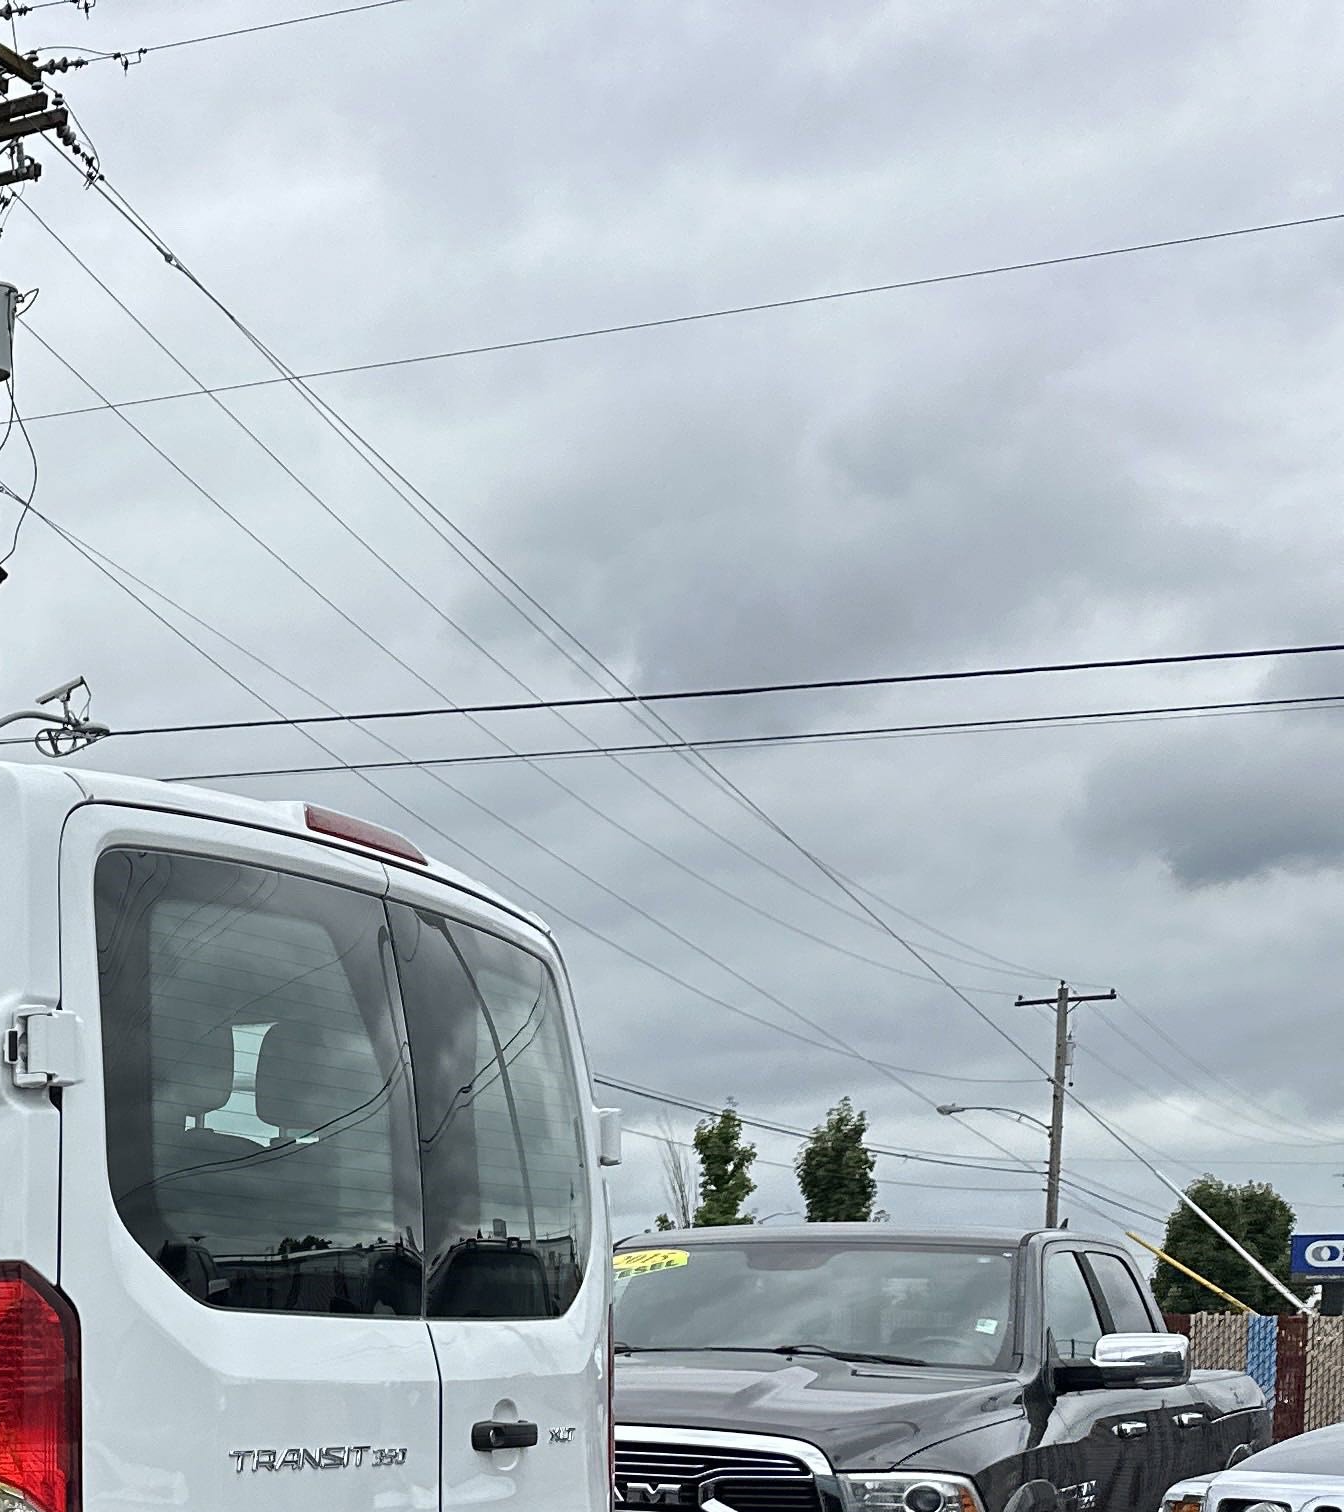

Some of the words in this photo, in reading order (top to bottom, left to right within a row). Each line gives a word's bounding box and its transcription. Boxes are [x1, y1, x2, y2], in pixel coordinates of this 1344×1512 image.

[548, 1426, 576, 1443] XLT
[228, 1445, 371, 1473] TRANSIT
[372, 1448, 408, 1467] 350
